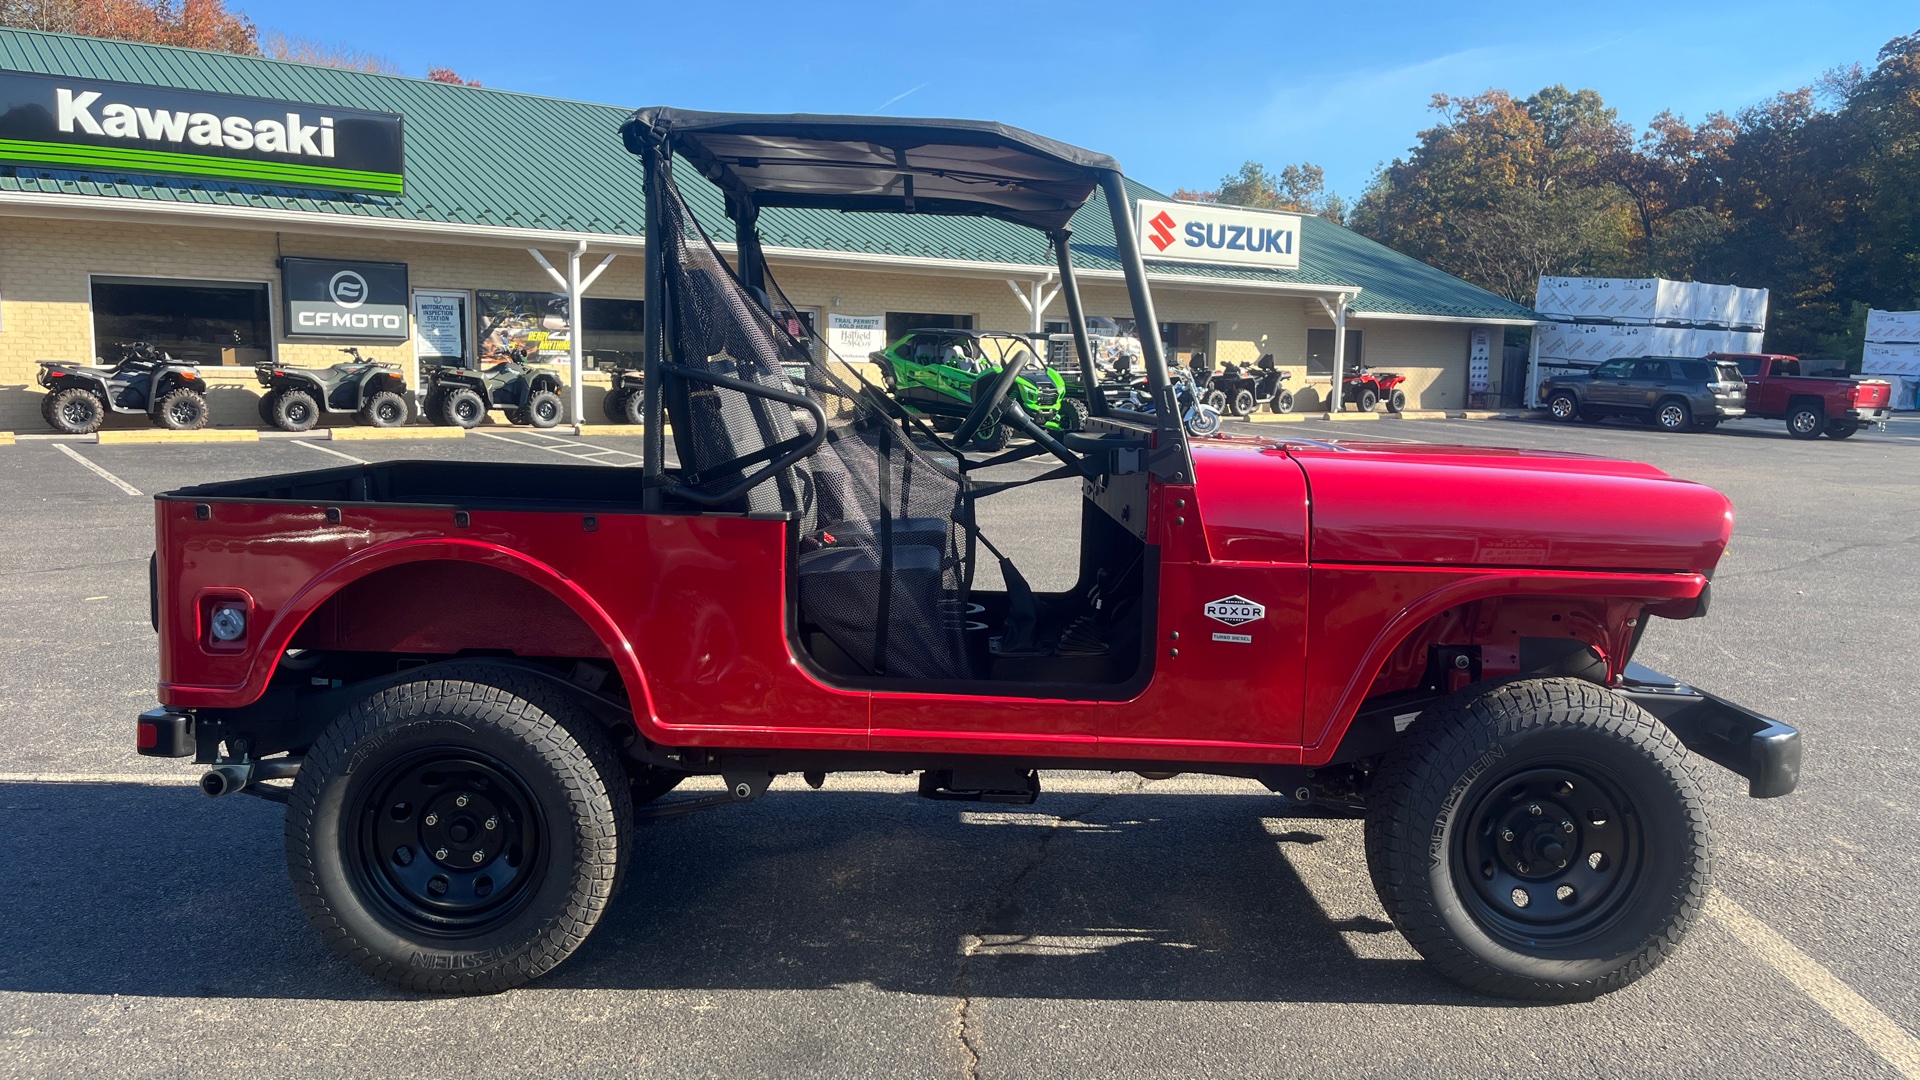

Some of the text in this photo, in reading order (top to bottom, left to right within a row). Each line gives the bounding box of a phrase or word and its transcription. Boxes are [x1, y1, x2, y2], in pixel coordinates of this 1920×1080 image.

[56, 88, 335, 158] Kawasaki
[1184, 220, 1292, 255] SUZUKI
[298, 311, 401, 329] CFMOTO
[527, 331, 550, 341] READY
[840, 330, 871, 341] Hatfield
[1207, 606, 1262, 617] ROXOR
[1429, 744, 1507, 871] VREDESTEIN
